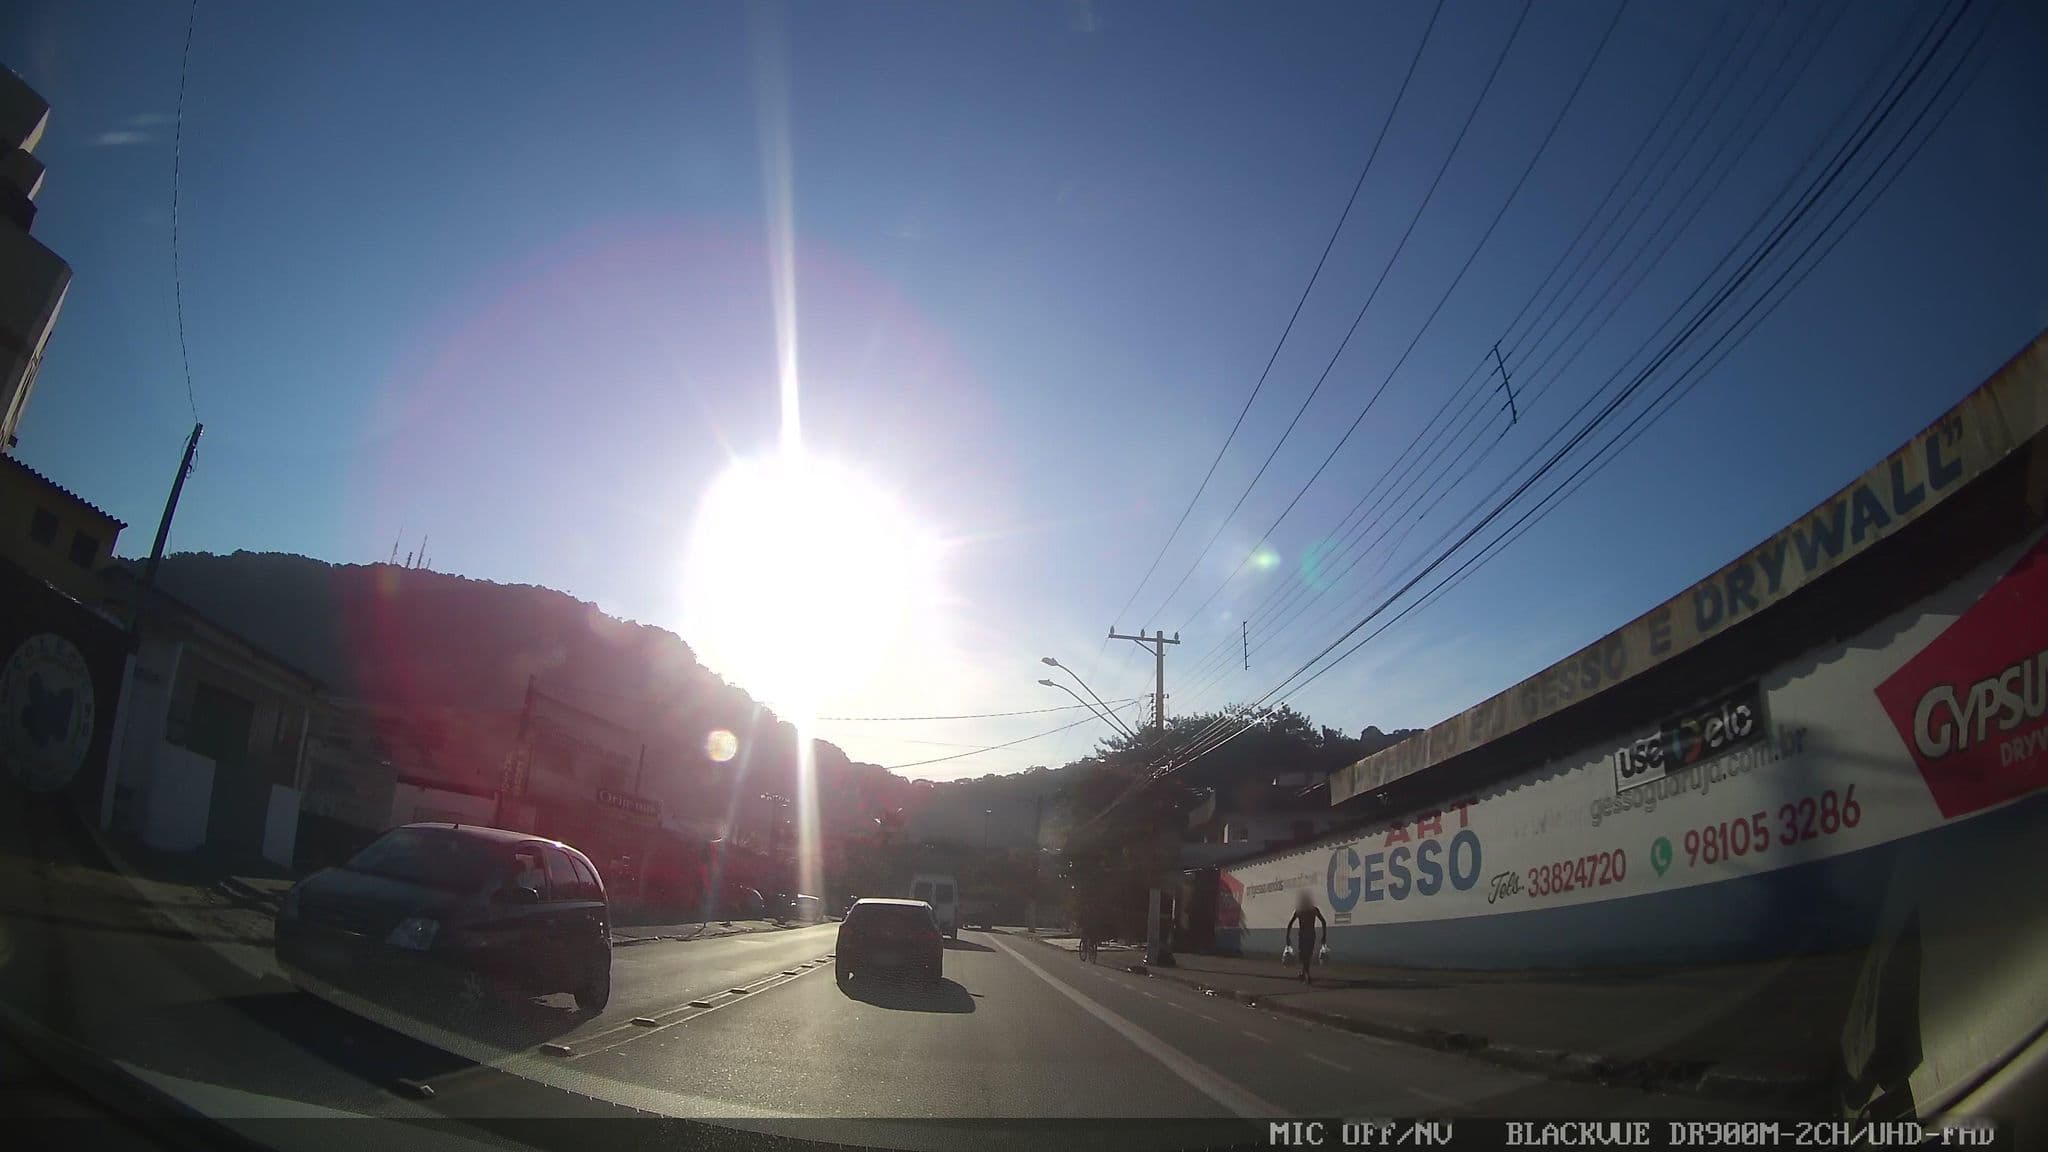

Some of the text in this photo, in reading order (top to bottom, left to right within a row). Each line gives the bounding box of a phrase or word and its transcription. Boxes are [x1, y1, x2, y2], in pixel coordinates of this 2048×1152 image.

[1521, 636, 1629, 716] GESSO
[1650, 614, 1673, 657] E
[1620, 741, 1664, 778] use
[1383, 801, 1479, 848] ART
[1528, 849, 1626, 898] 33824720
[1684, 811, 1770, 868] 98105
[1779, 784, 1861, 844] 3286
[1327, 830, 1481, 913] GESSO
